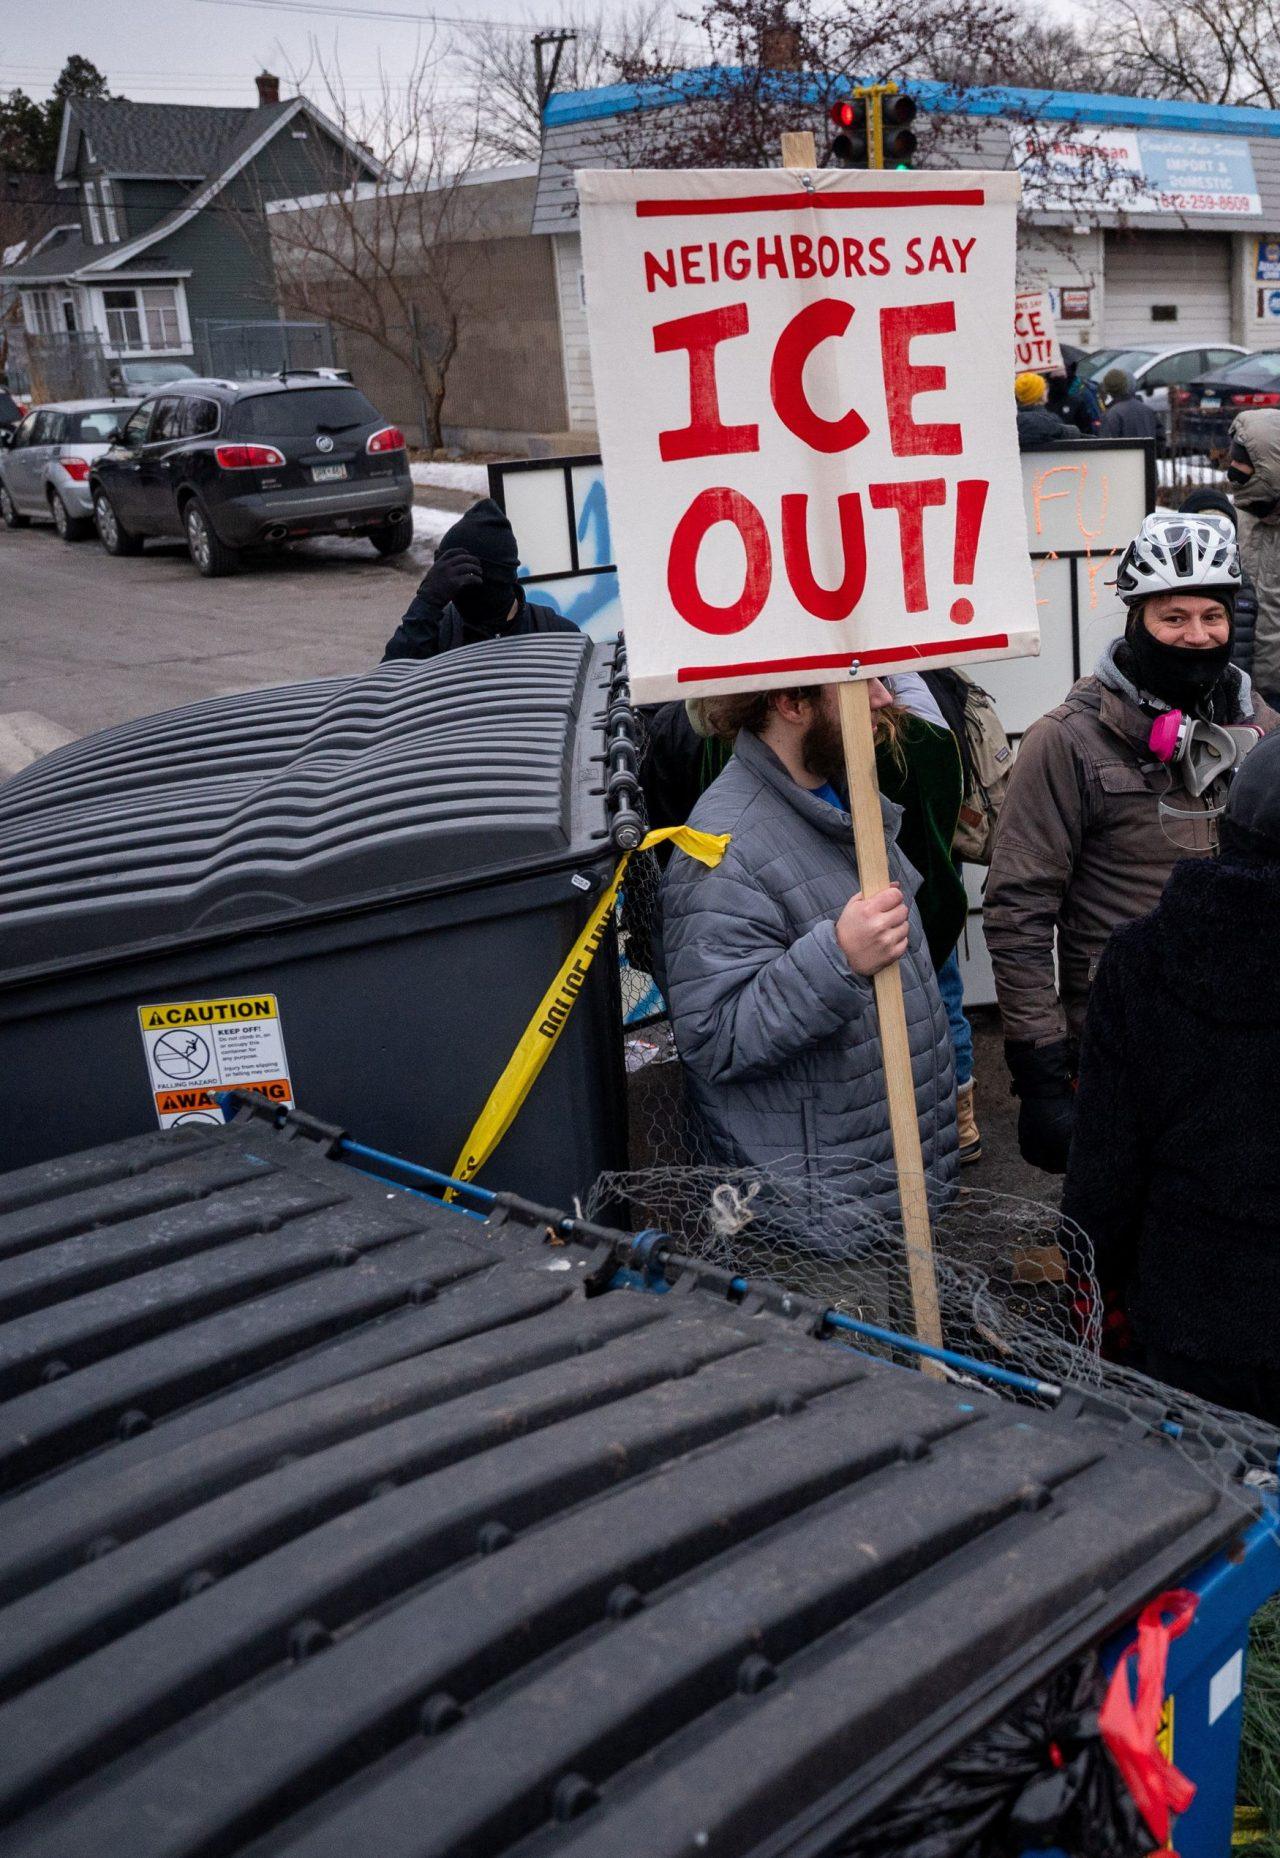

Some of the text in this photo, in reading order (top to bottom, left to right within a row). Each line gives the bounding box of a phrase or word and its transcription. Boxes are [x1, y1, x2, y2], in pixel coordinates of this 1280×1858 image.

[643, 232, 977, 293] NEIGHBORS SAY
[1015, 311, 1045, 337] CE
[1015, 339, 1052, 364] UT!
[650, 297, 964, 463] ICE
[666, 477, 991, 638] OUT!
[166, 1000, 271, 1024] CAUTION
[157, 1078, 218, 1090] FALLING HAZARD
